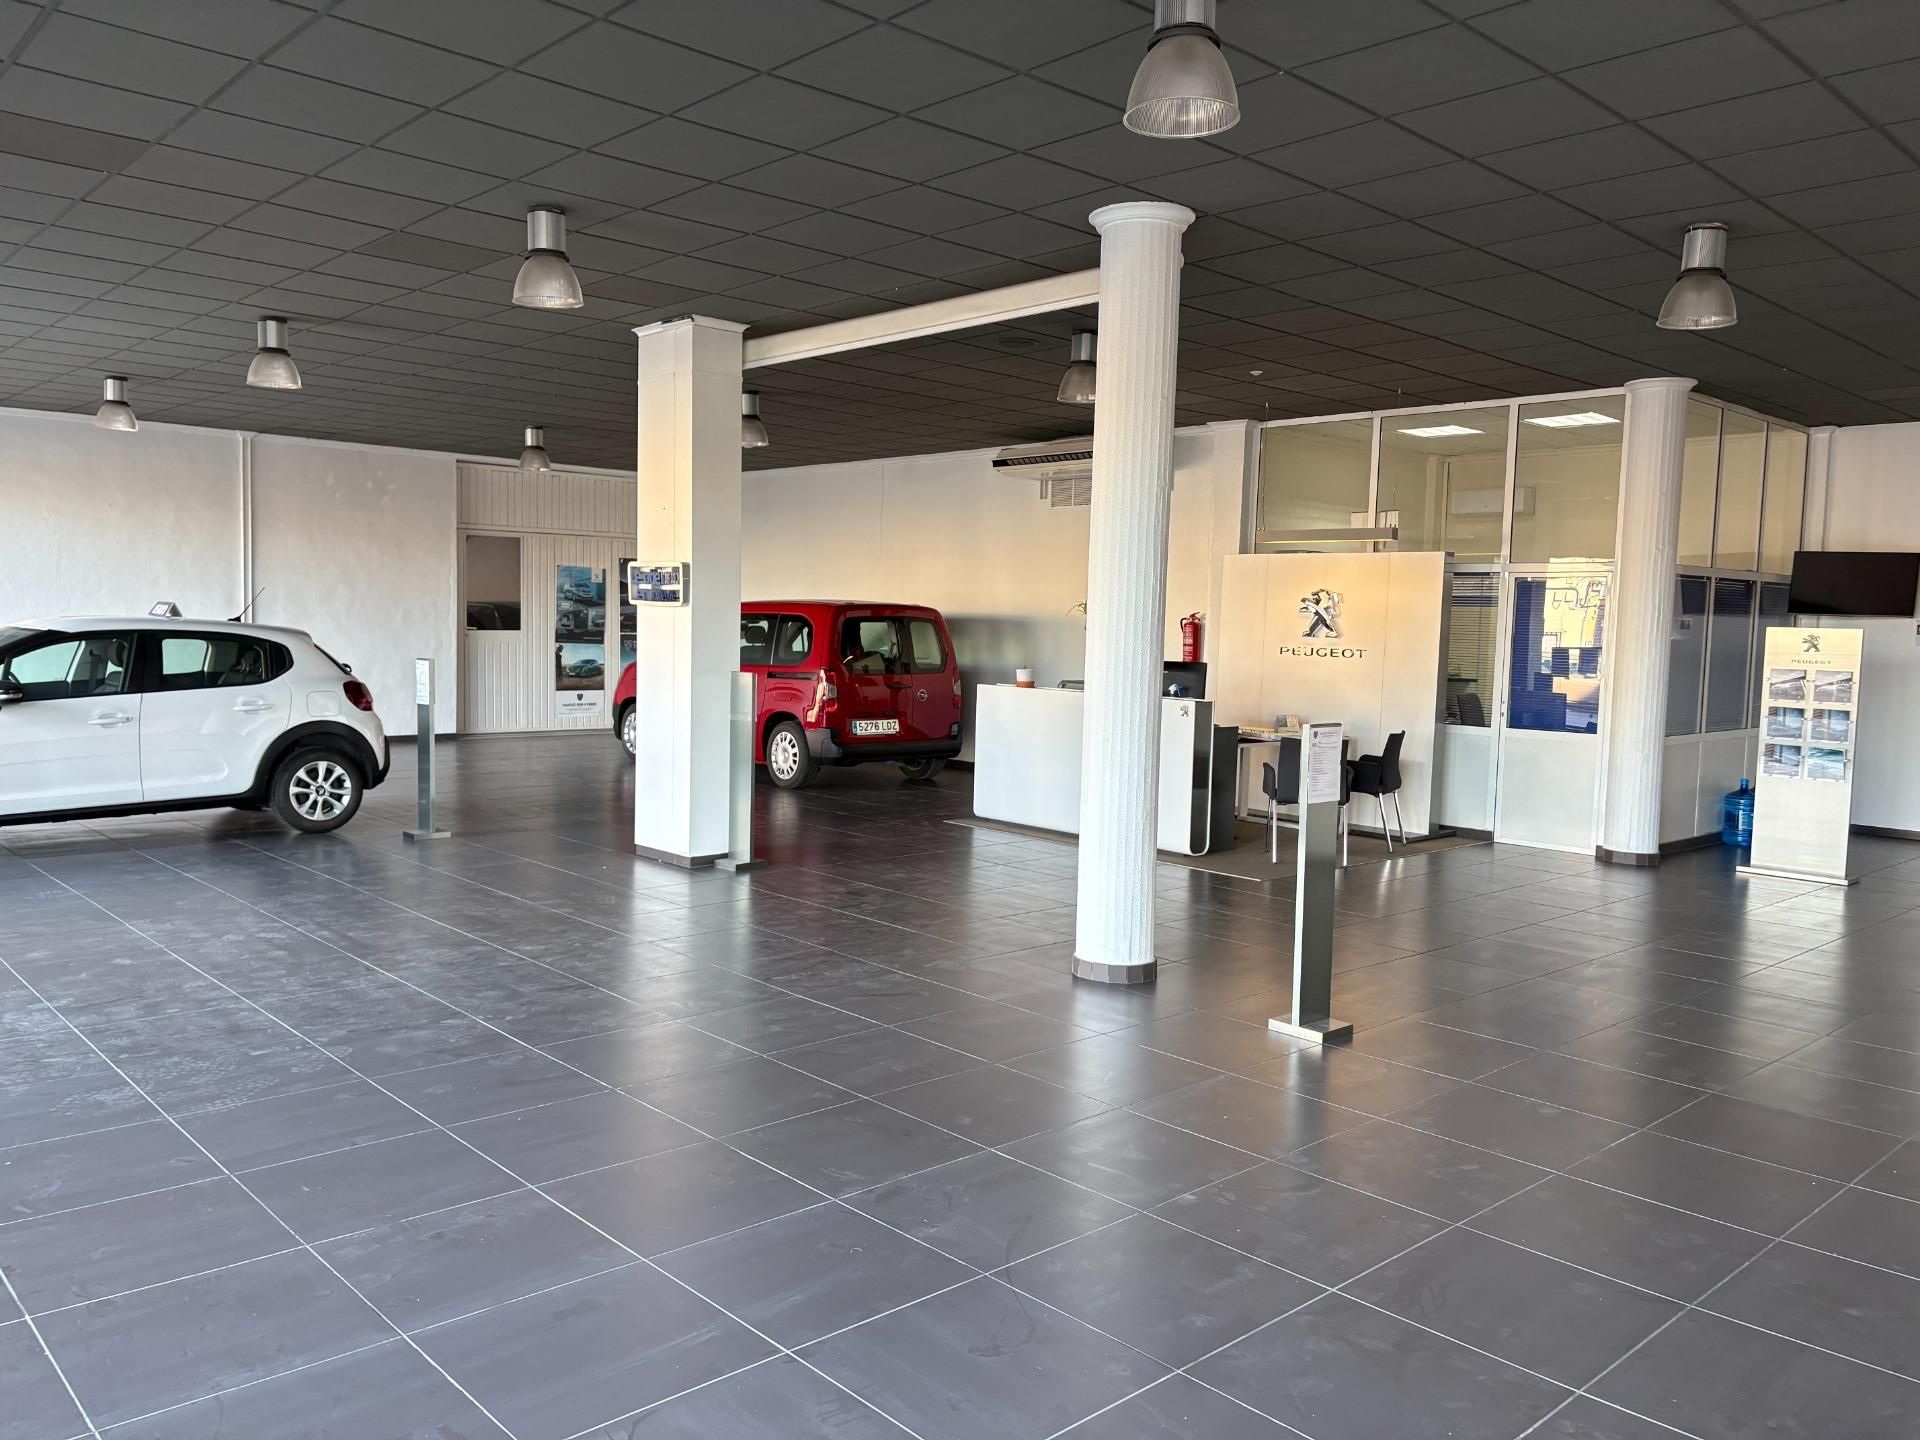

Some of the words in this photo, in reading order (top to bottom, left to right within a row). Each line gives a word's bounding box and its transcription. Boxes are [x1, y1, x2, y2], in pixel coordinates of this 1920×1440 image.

[1279, 646, 1367, 658] PEUGEOT
[858, 721, 880, 732] 5276
[881, 720, 897, 731] LDZ
